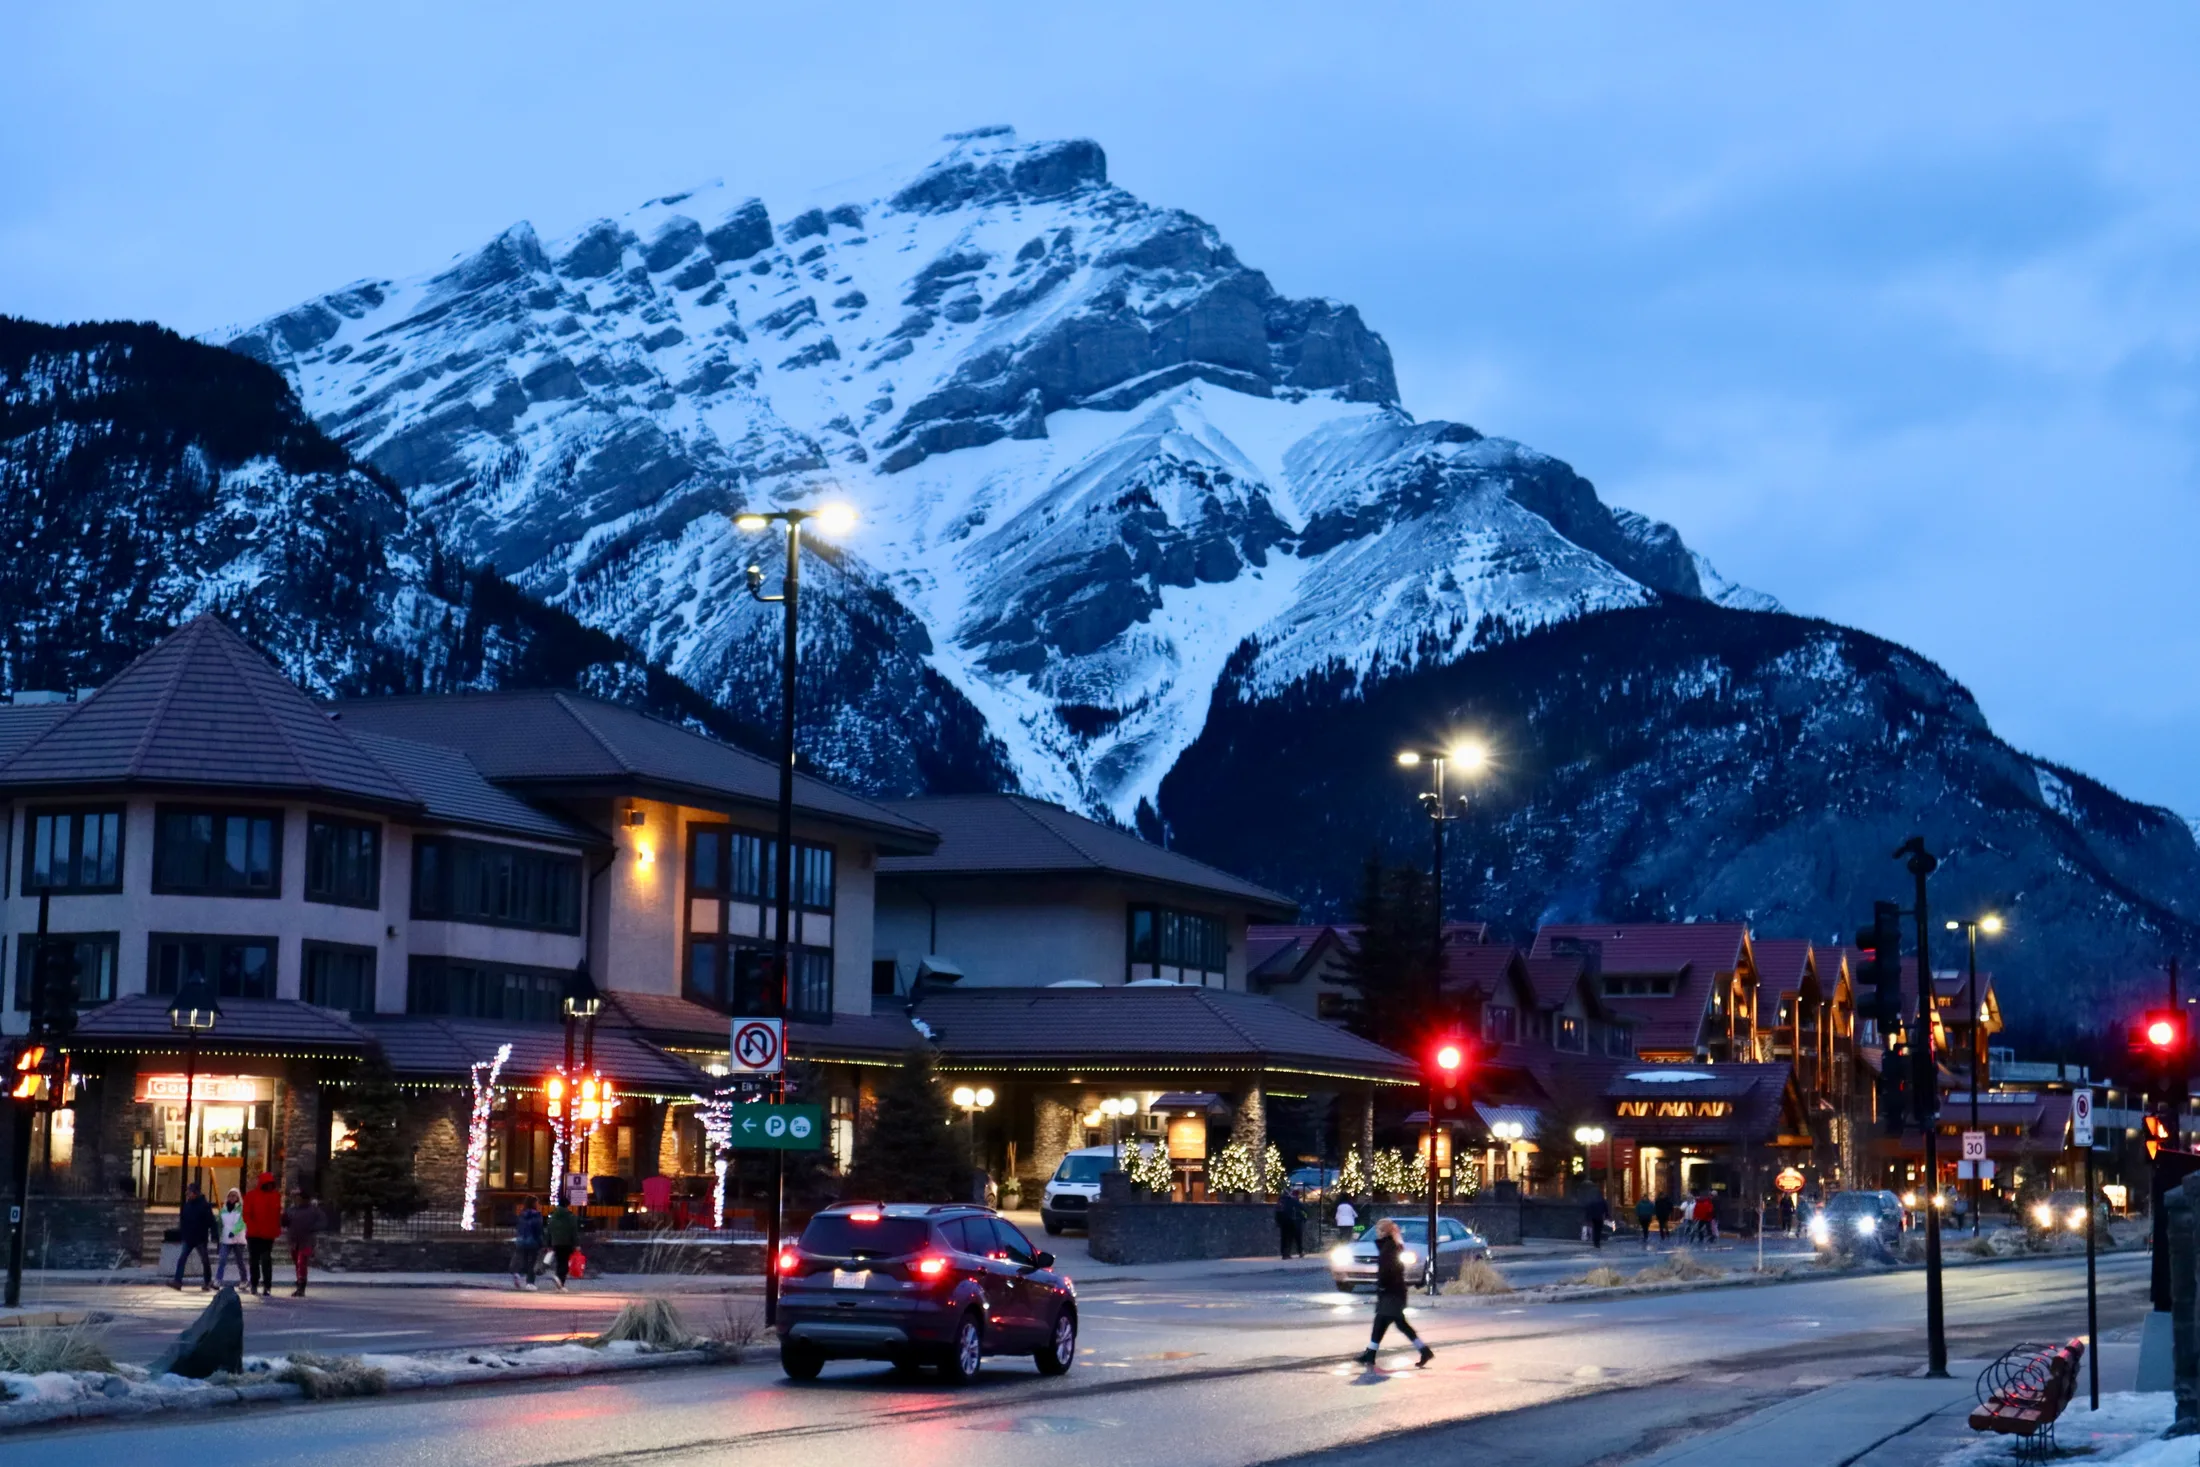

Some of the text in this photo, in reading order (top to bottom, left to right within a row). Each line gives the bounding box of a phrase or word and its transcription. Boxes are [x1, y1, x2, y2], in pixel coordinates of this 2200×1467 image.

[741, 1082, 753, 1092] Elk
[770, 1119, 782, 1133] P
[1966, 1142, 1983, 1155] 30
